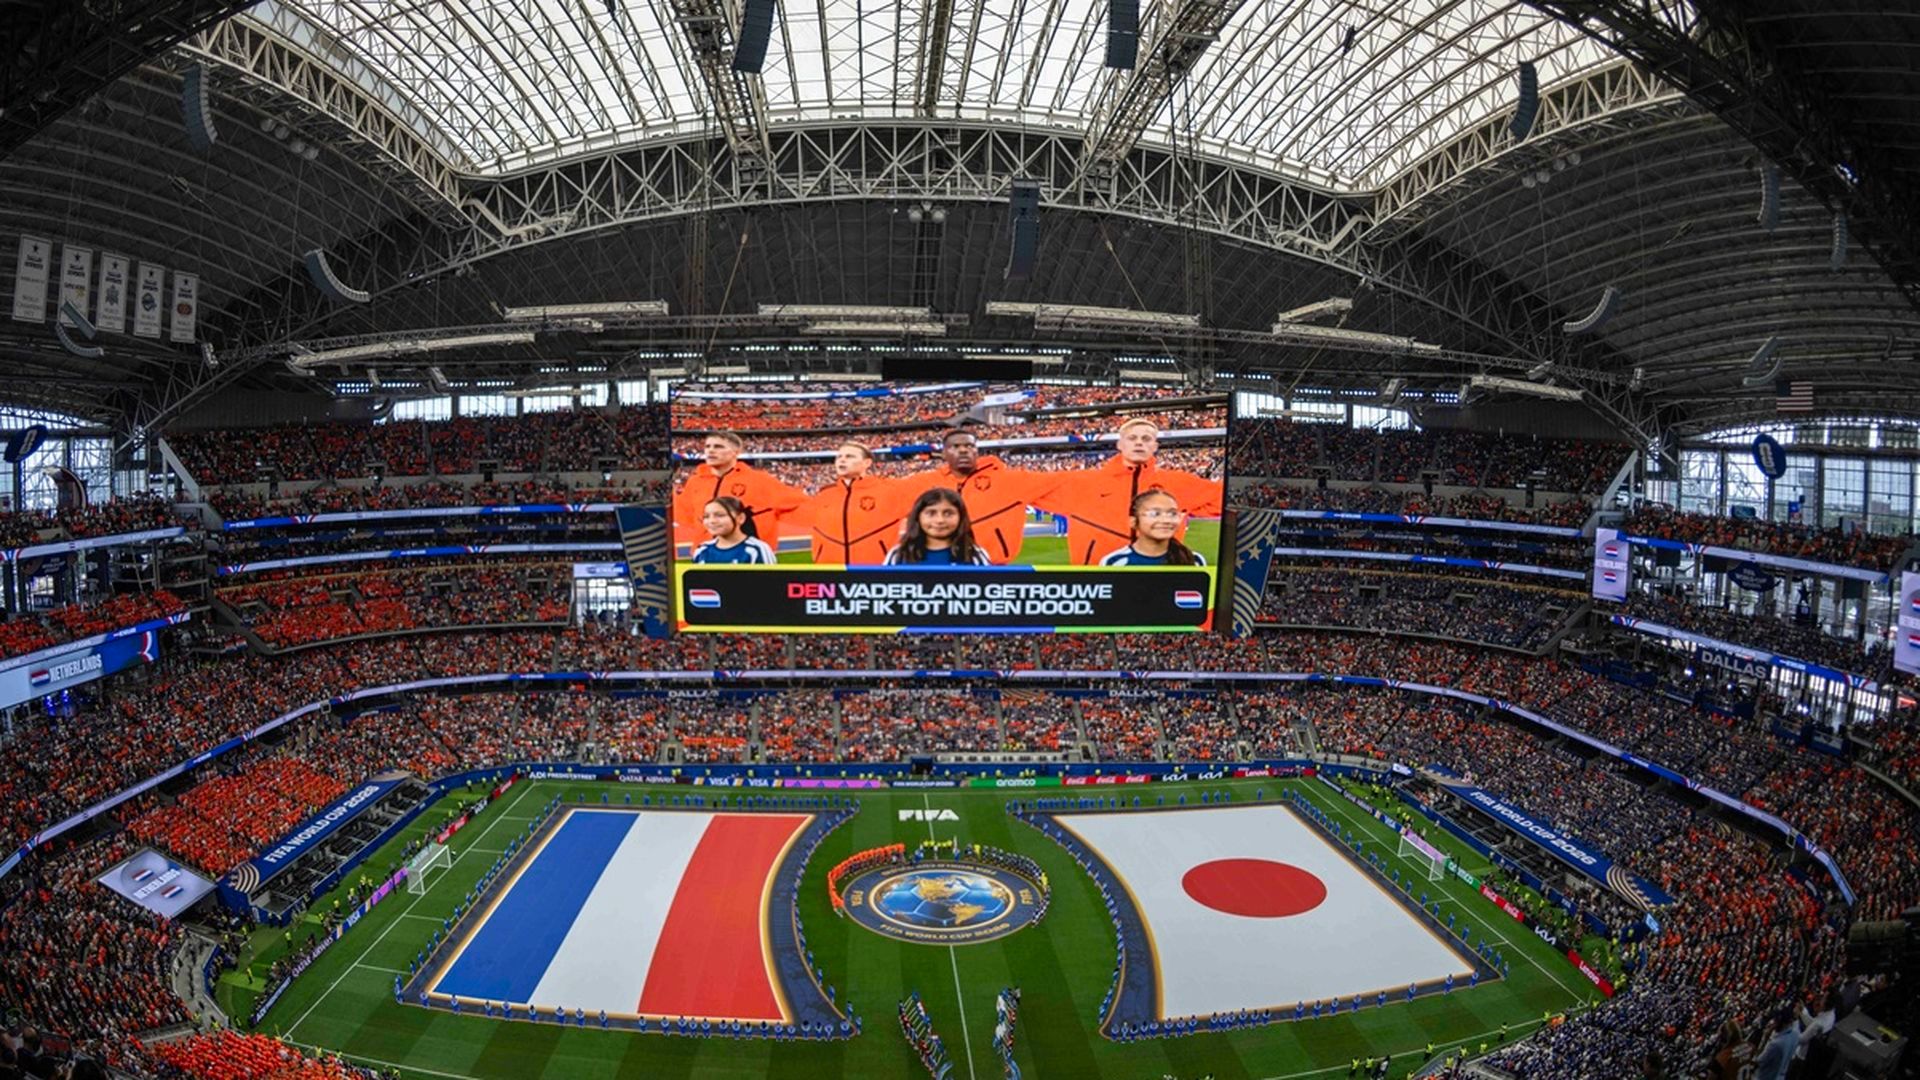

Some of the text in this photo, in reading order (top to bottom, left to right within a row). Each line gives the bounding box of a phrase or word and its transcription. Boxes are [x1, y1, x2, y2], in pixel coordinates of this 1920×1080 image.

[787, 584, 1112, 599] DEN VADERLAND GETROUWE
[805, 600, 1094, 615] BLIJF IK TOT IN DEN DOOD.
[49, 653, 103, 682] NETHERLANDS
[1701, 650, 1766, 679] DALLAS
[709, 778, 769, 787] VISA VISA
[996, 778, 1036, 787] aramco
[898, 808, 960, 821] FIFA
[264, 785, 380, 863] FIFA WORLD CUP 2026
[1470, 791, 1598, 865] FIFA WORLD CUP 2026
[133, 868, 182, 899] NETHERLANDS
[904, 930, 948, 939] WORLD
[948, 931, 973, 939] CUP
[1534, 926, 1557, 945] KIA
